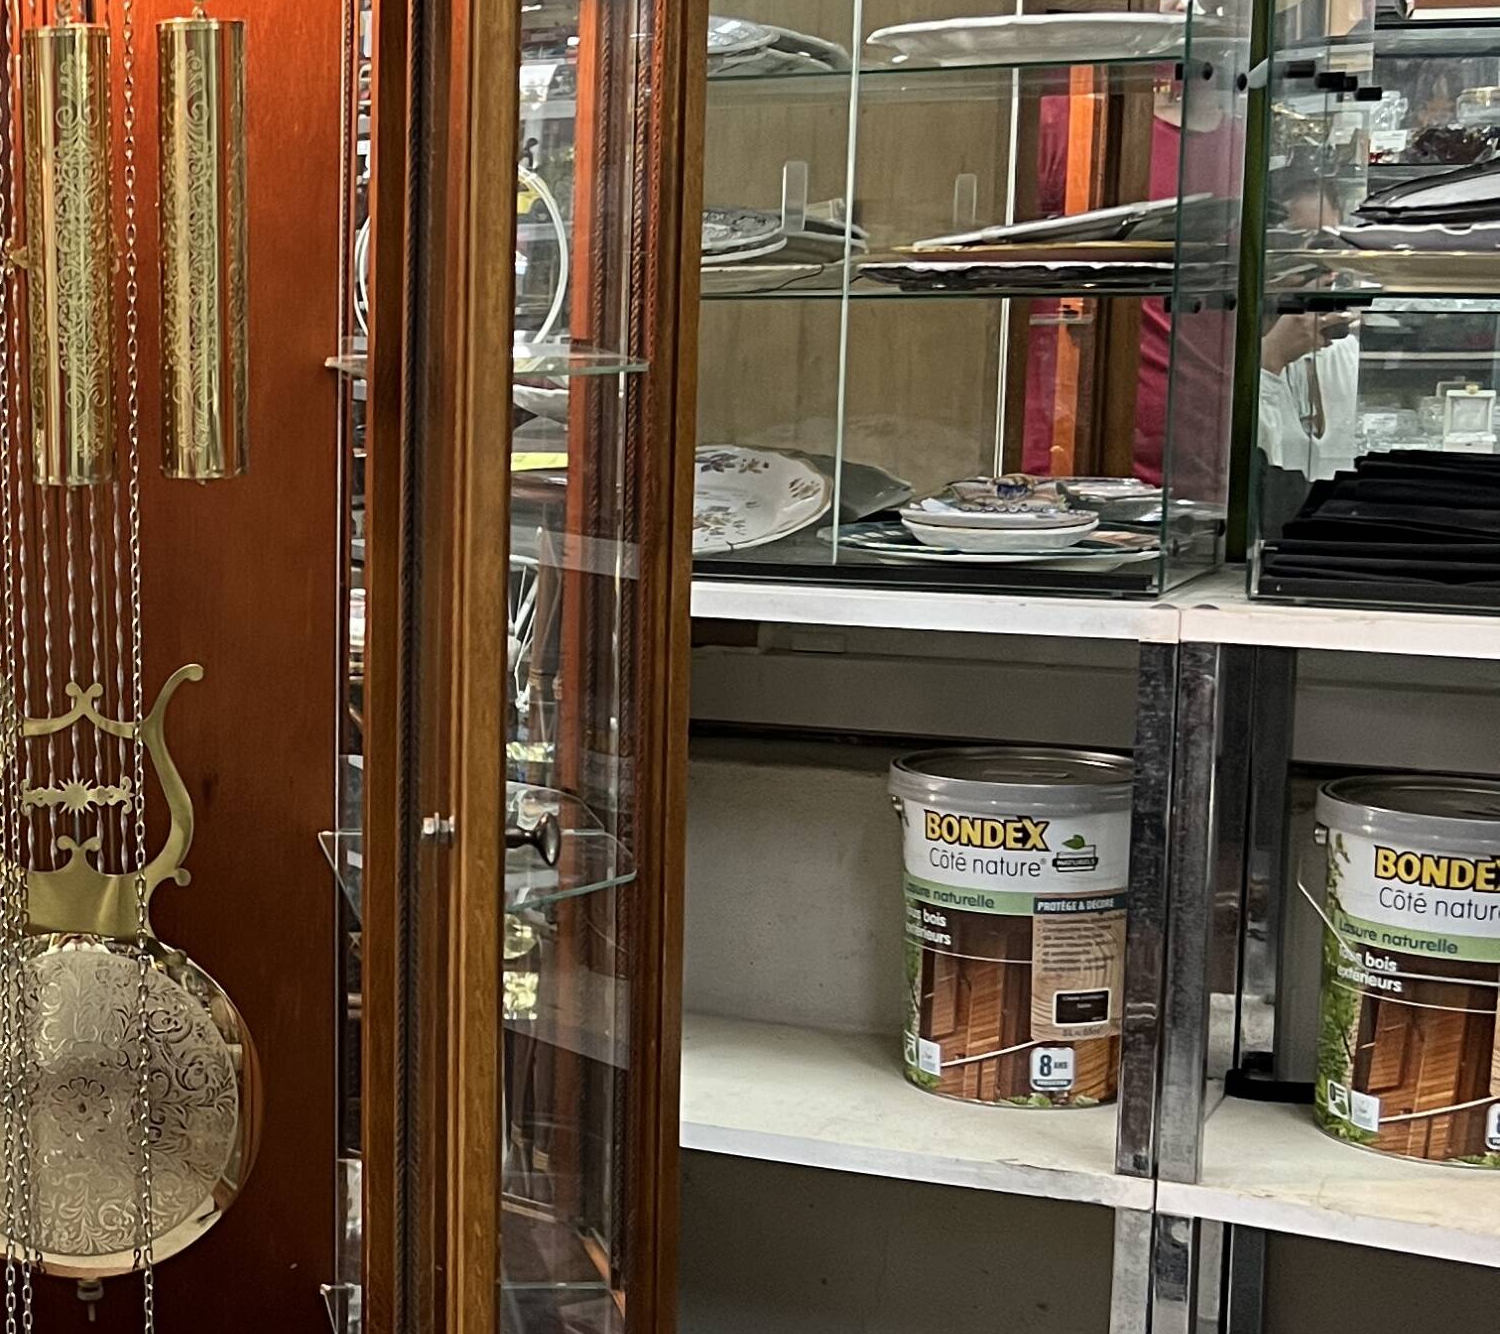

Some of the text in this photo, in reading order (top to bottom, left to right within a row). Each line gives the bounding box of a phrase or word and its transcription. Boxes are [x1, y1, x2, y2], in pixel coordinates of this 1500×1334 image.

[923, 809, 1052, 853] BONDEX
[929, 846, 1041, 878] Côté nature
[1373, 844, 1500, 893] BONDE
[933, 889, 995, 909] naturelle
[1379, 886, 1500, 922] Côté natur
[922, 907, 948, 927] bois
[1381, 932, 1459, 955] naturelle
[1364, 950, 1398, 973] bois
[1038, 1053, 1053, 1078] 8
